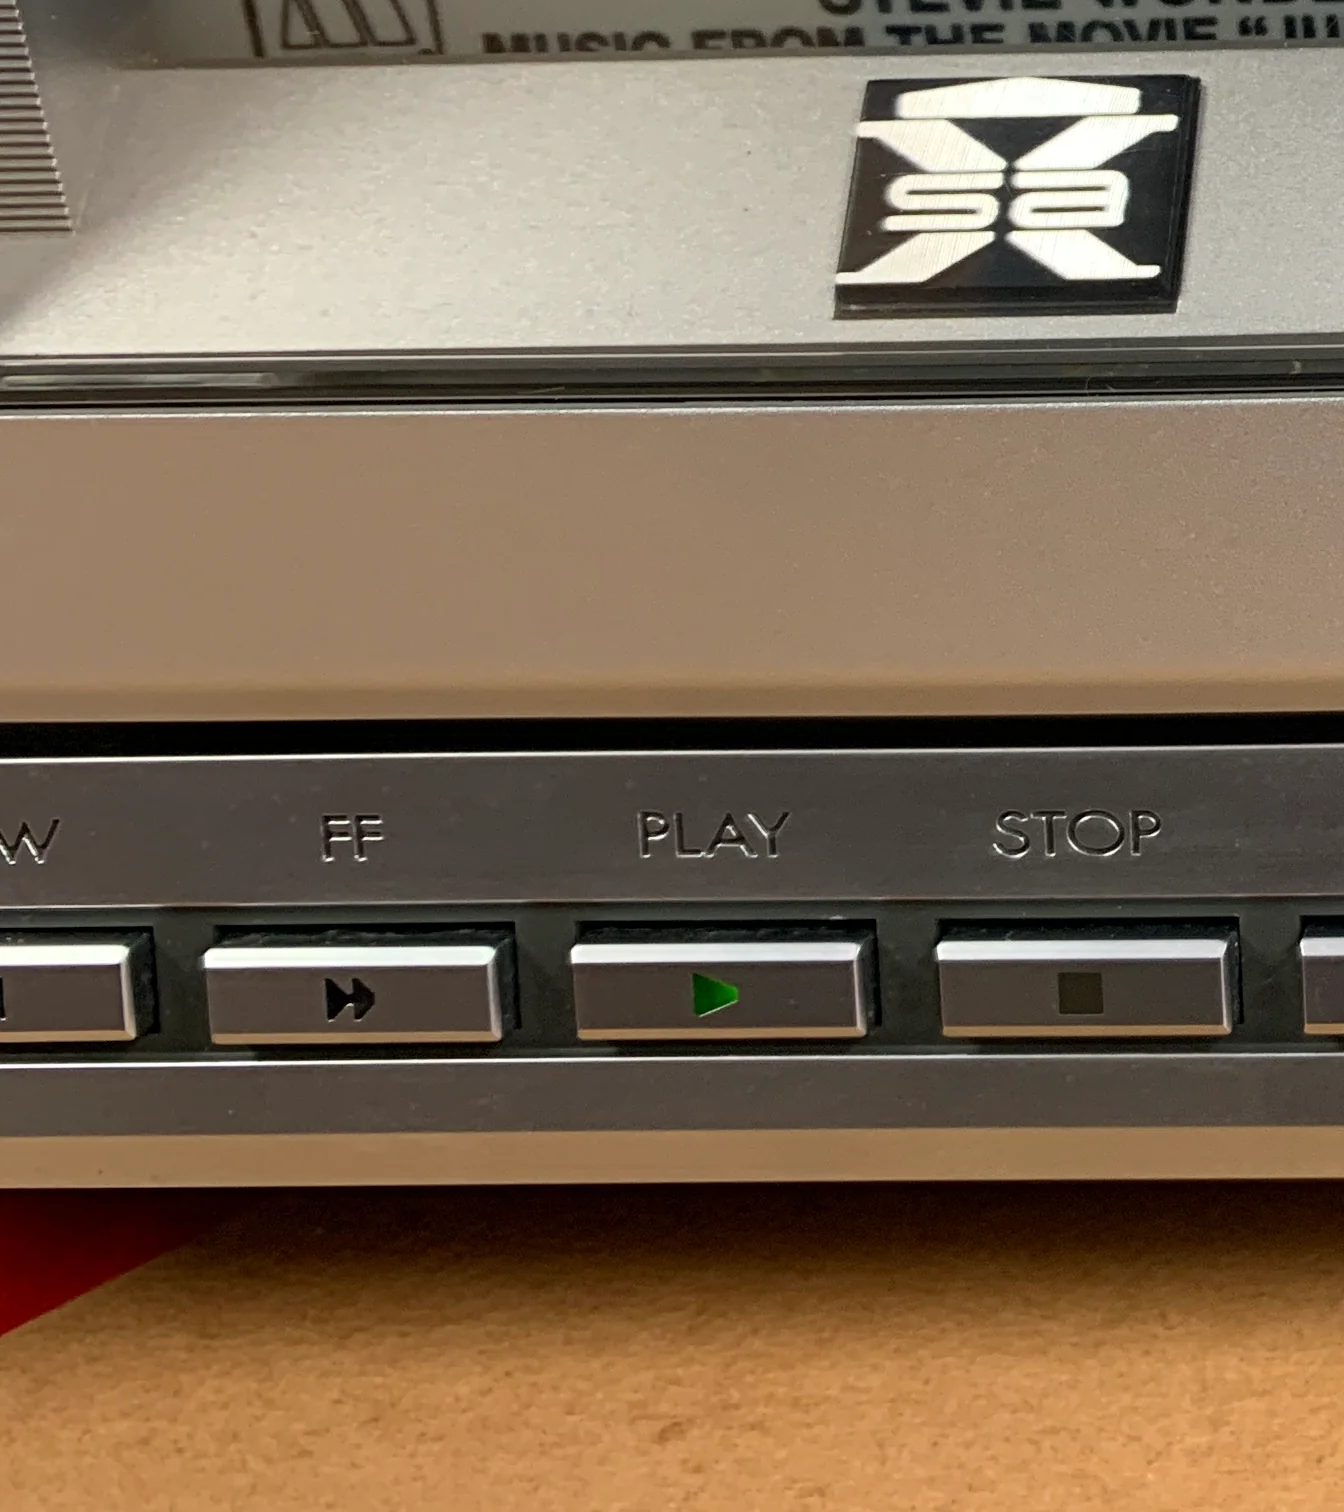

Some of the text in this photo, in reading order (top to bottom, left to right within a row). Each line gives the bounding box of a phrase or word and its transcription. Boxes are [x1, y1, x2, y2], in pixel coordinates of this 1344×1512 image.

[320, 813, 385, 863] FF
[636, 812, 790, 859] PLAY
[992, 810, 1163, 858] STOP
